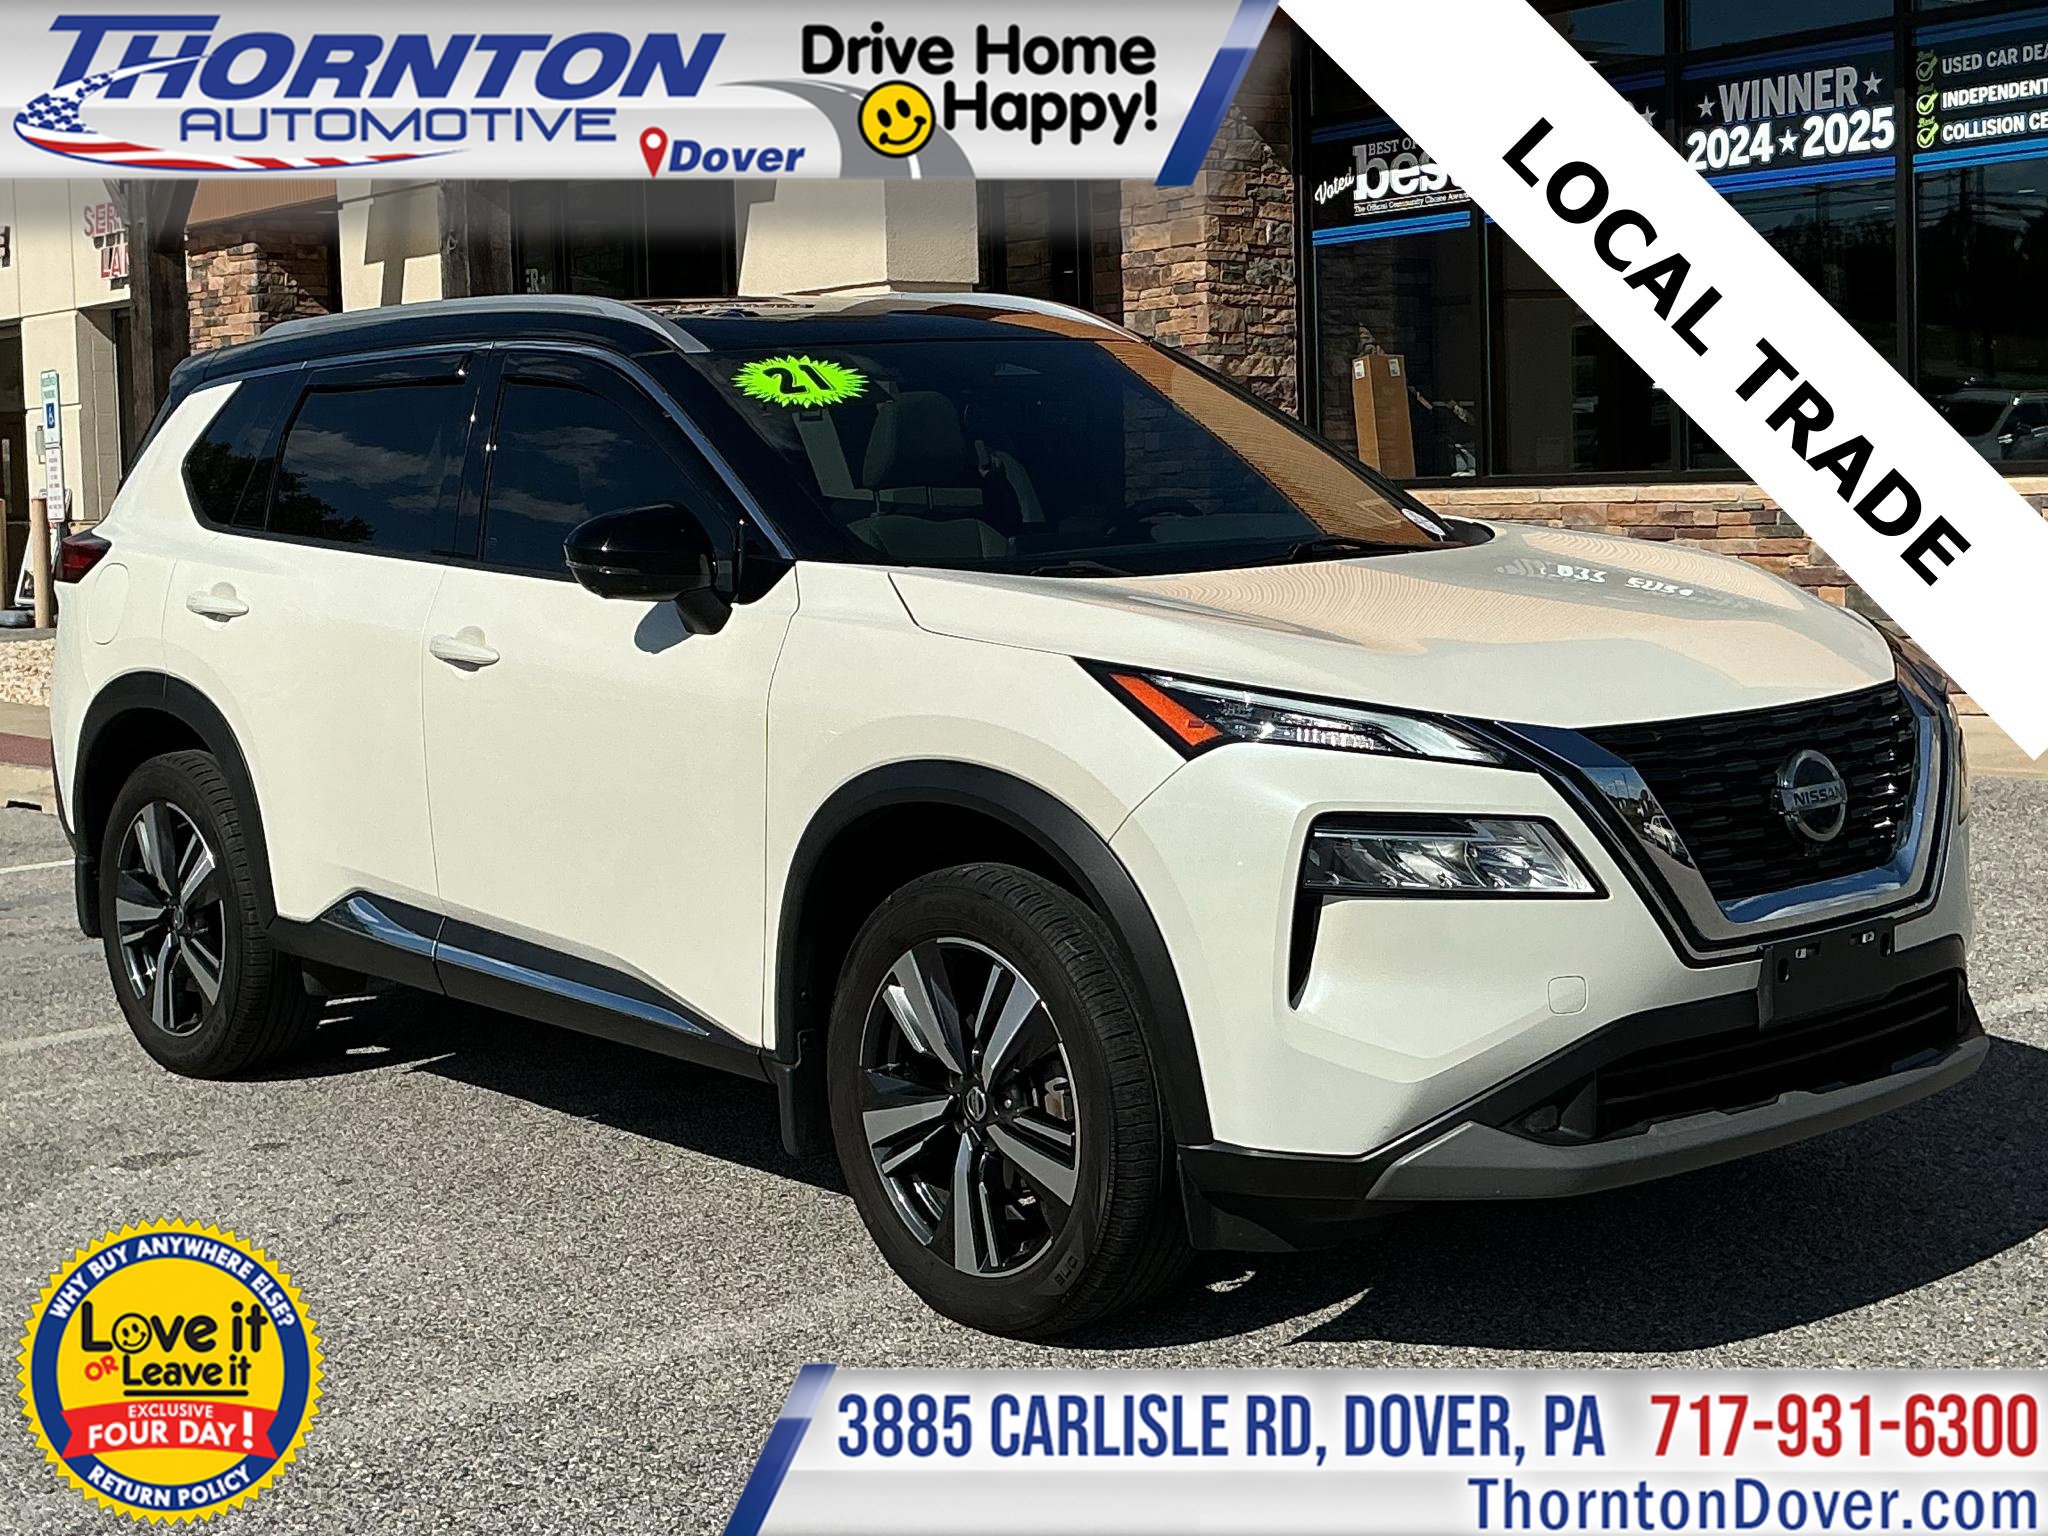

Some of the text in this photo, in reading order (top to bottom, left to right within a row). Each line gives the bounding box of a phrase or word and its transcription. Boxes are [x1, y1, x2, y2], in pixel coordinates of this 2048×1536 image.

[1941, 54, 1983, 75] USED
[1986, 48, 2018, 68] CAR
[1718, 66, 1859, 123] WINNER
[1942, 78, 2048, 109] INDEPENDENT
[1687, 106, 1895, 171] 2024 2025
[1942, 114, 2026, 142] COLLISION
[1368, 139, 1400, 156] BEST
[1314, 166, 1355, 205] Voted
[762, 364, 836, 395] 21
